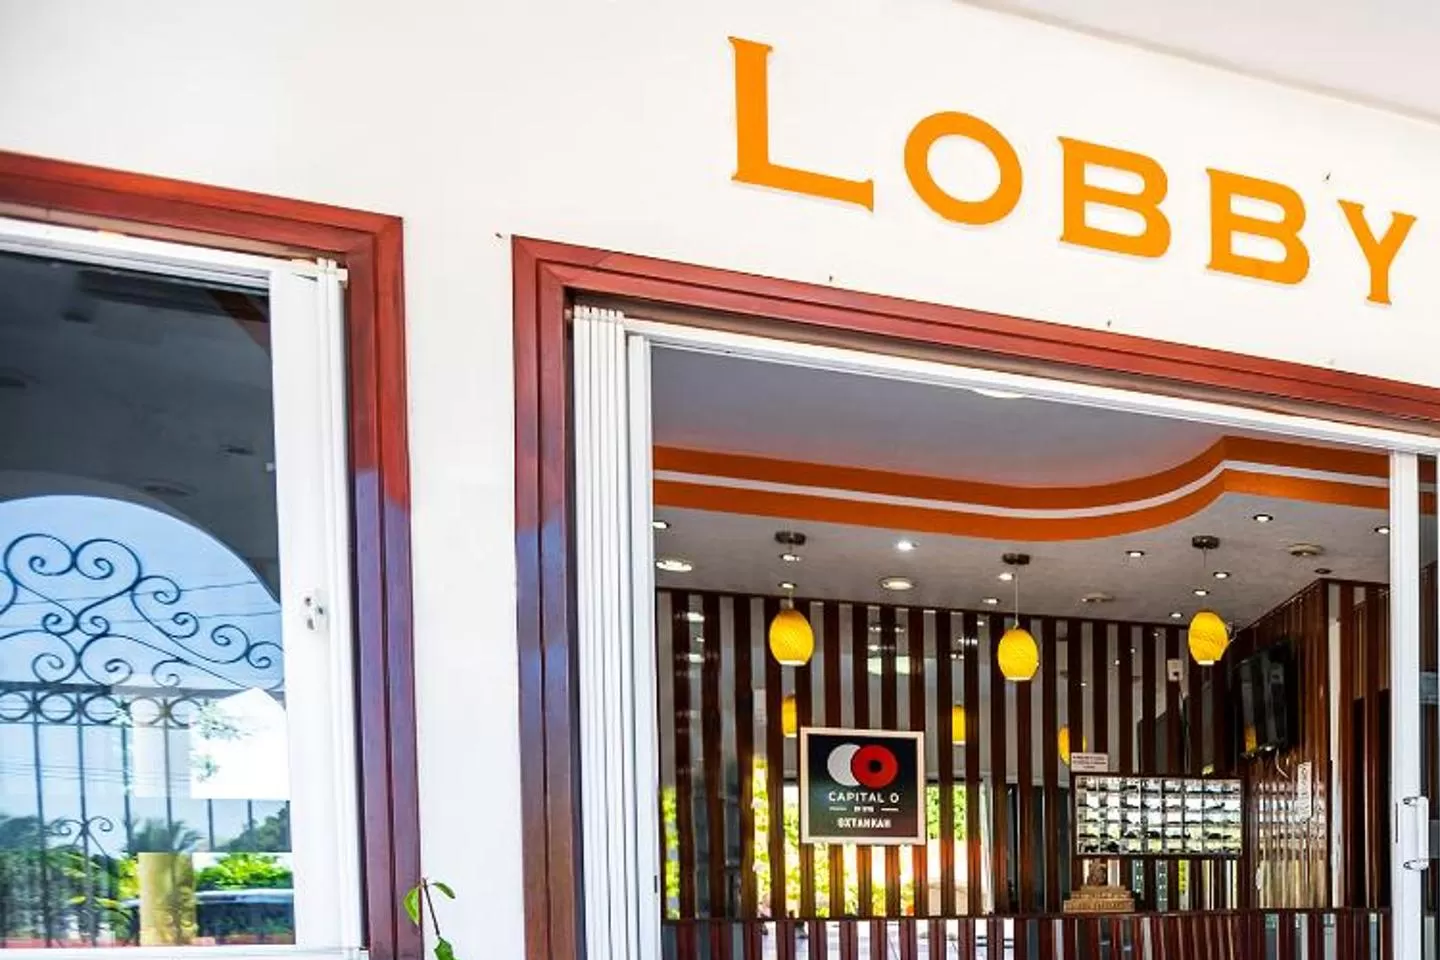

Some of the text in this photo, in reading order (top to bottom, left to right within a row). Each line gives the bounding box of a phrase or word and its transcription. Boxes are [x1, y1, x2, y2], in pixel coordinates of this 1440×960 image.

[728, 36, 1417, 305] LOBBY
[828, 791, 900, 804] CAPITAL O
